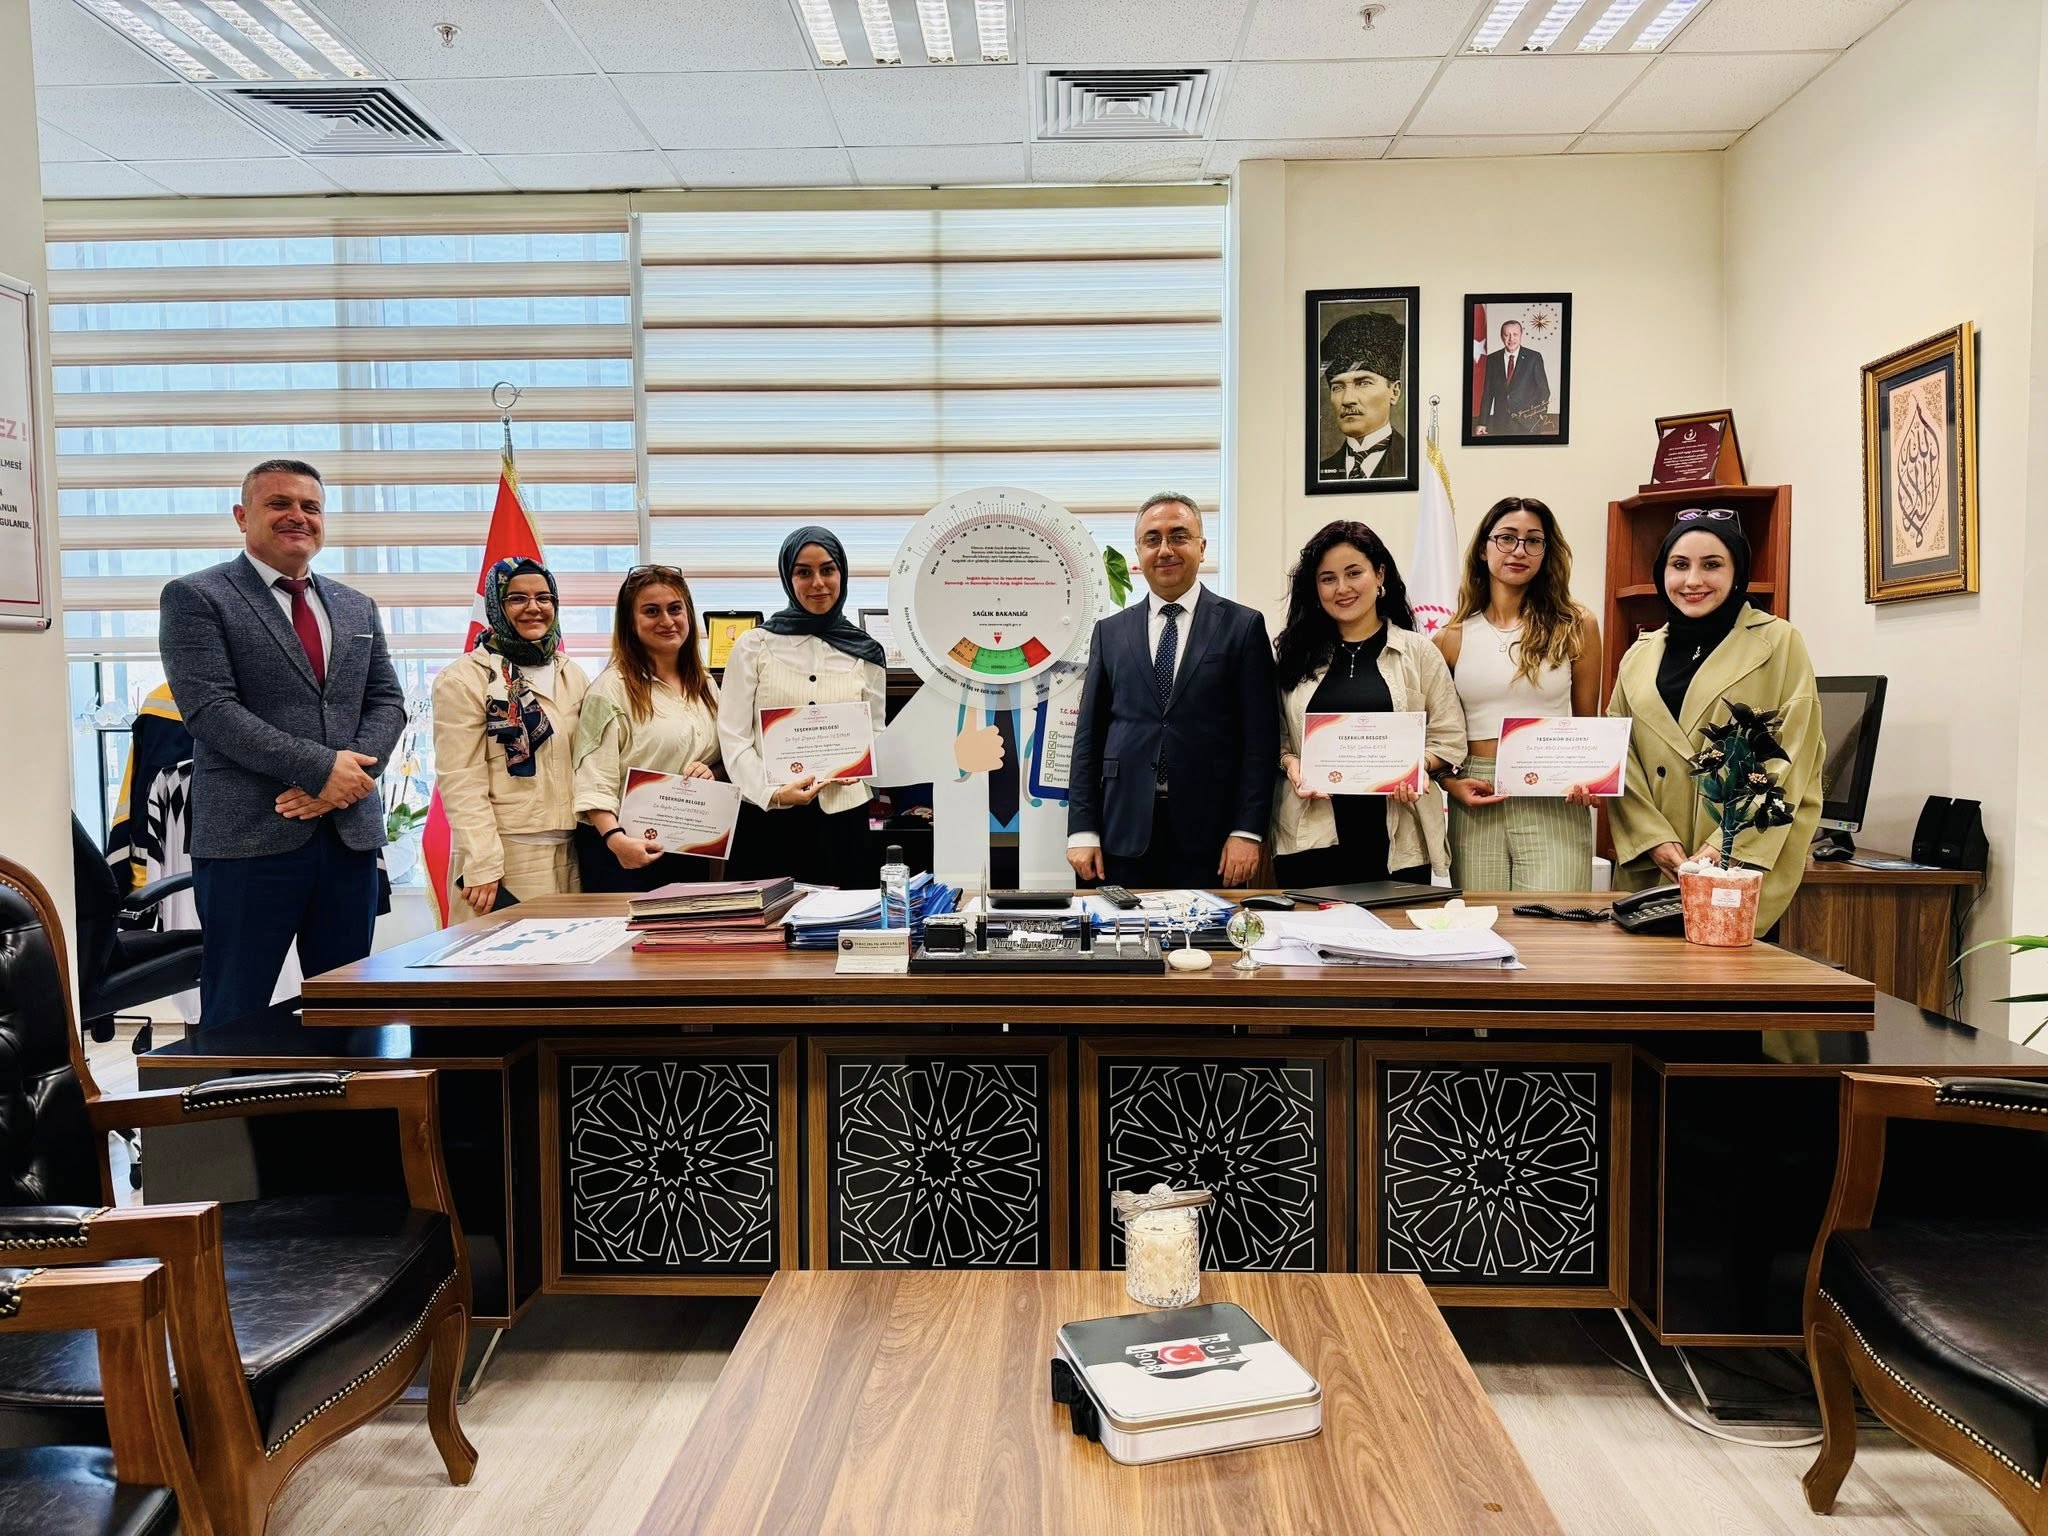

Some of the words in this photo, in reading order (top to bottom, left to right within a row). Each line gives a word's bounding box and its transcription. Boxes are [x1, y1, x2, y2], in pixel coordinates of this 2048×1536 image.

[992, 938, 1018, 948] Yunus
[1020, 938, 1042, 949] Emre
[1132, 1349, 1161, 1372] 1903
[1198, 1335, 1236, 1364] BJK
